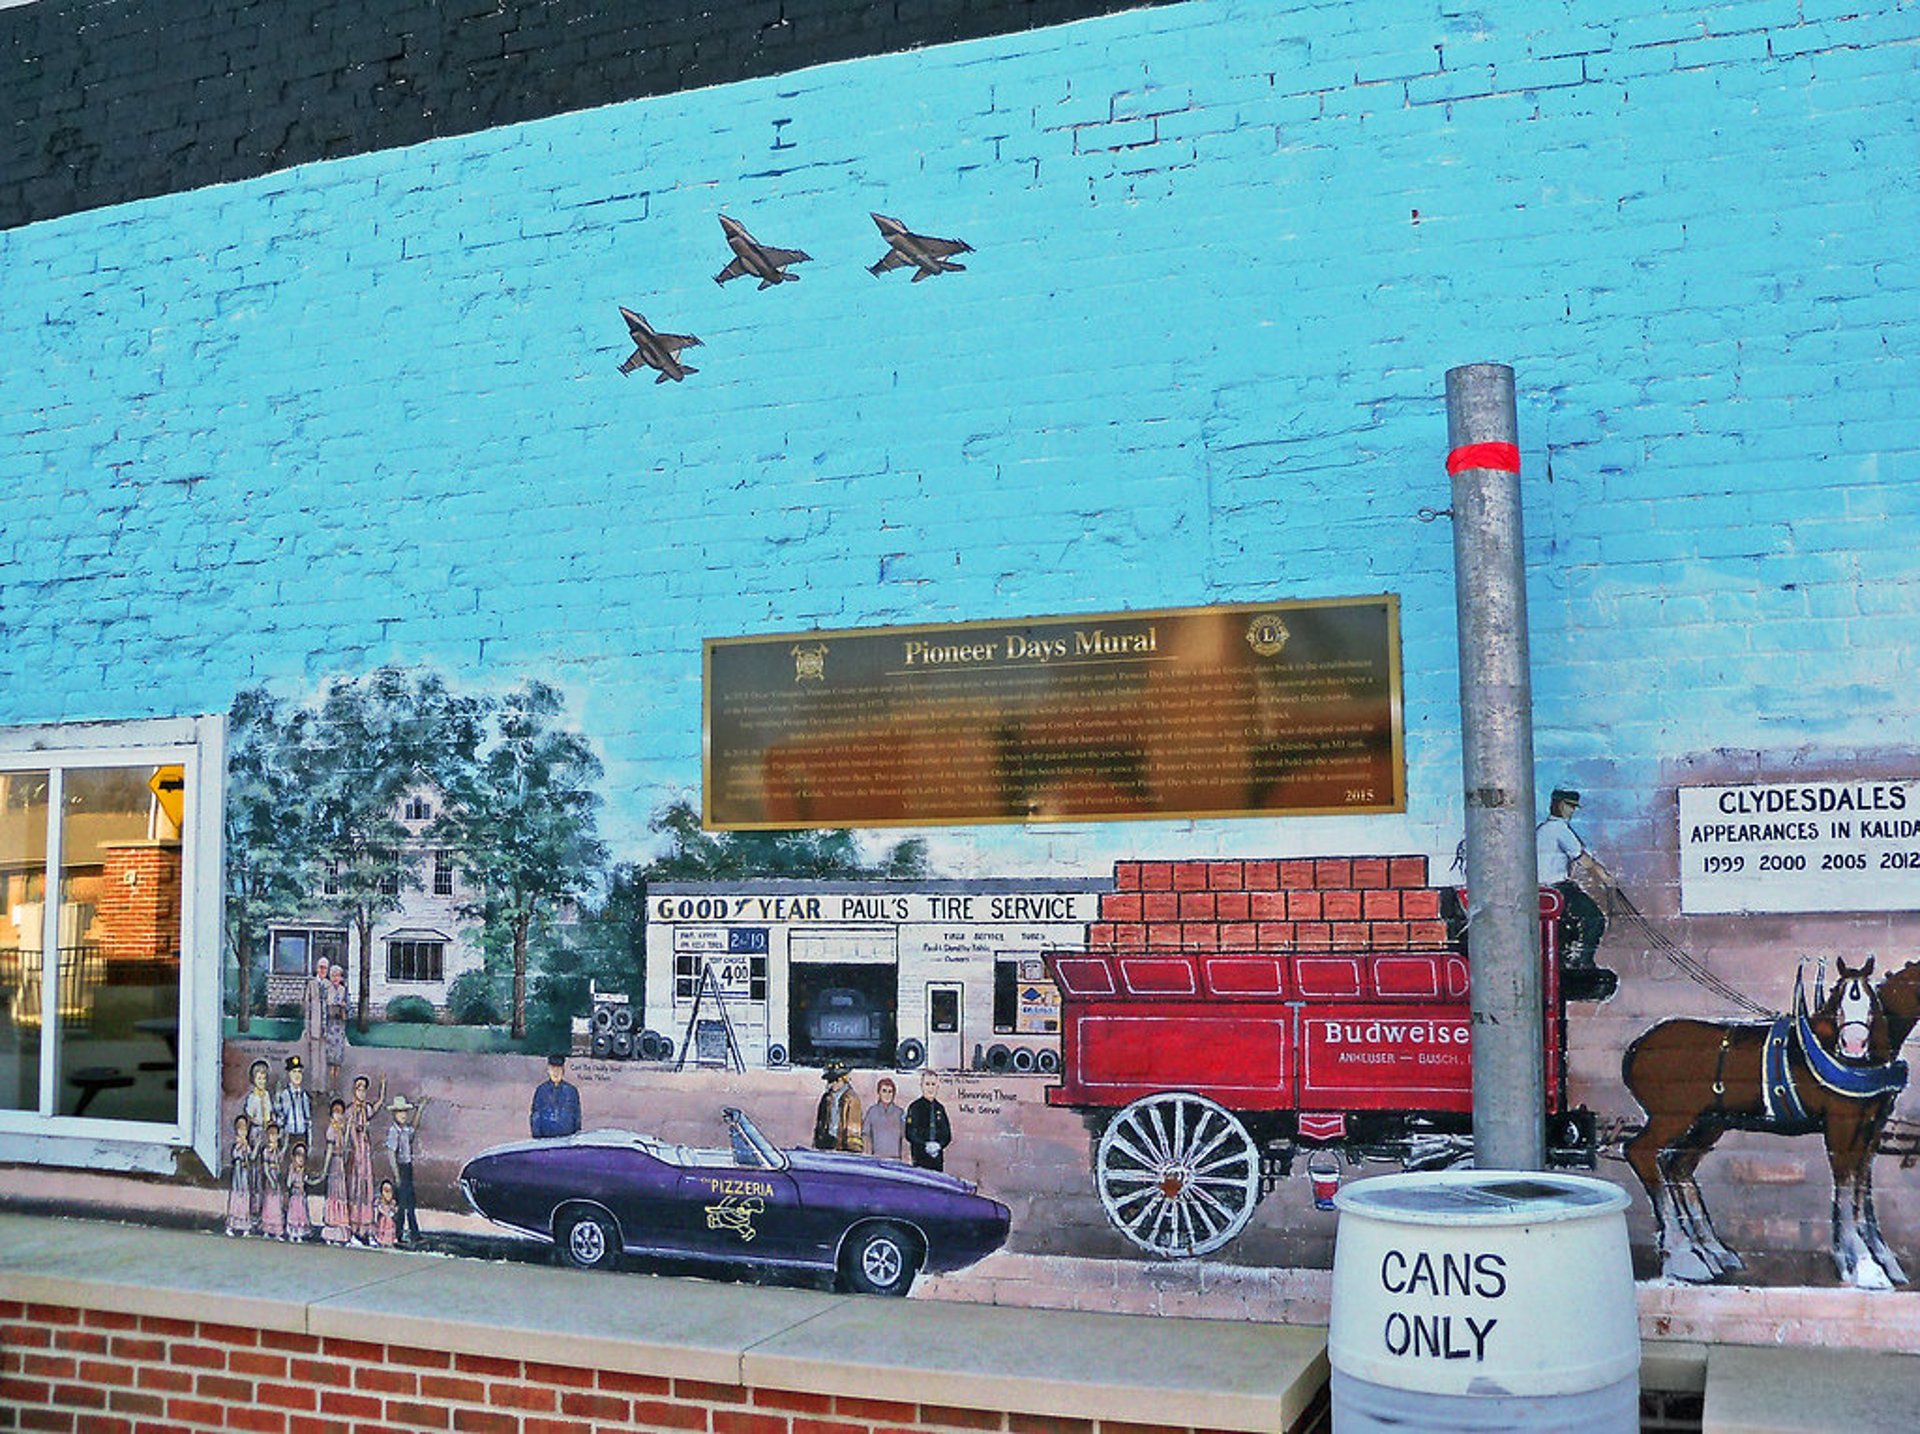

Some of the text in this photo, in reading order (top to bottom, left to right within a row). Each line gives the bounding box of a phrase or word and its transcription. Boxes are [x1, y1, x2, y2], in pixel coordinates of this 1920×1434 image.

[904, 627, 1159, 665] Pioneer Days Mural
[1344, 788, 1375, 802] 2015
[1718, 786, 1907, 814] CLYDESDALES
[1690, 821, 1819, 843] APPEARANCES
[1831, 821, 1850, 838] IN
[1703, 851, 1920, 873] 1999 2000 2005 2012
[658, 896, 1077, 920] GOOD YEAR PAUL'S TIRE SERVICE
[1324, 1020, 1470, 1044] Budweise
[1338, 1052, 1397, 1065] ANHEUSER
[957, 1088, 1017, 1102] Honoring Those
[959, 1104, 1001, 1114] Who Serve
[711, 1178, 775, 1197] PIZZERIA
[1381, 1250, 1507, 1298] CANS
[1385, 1312, 1498, 1361] ONLY
